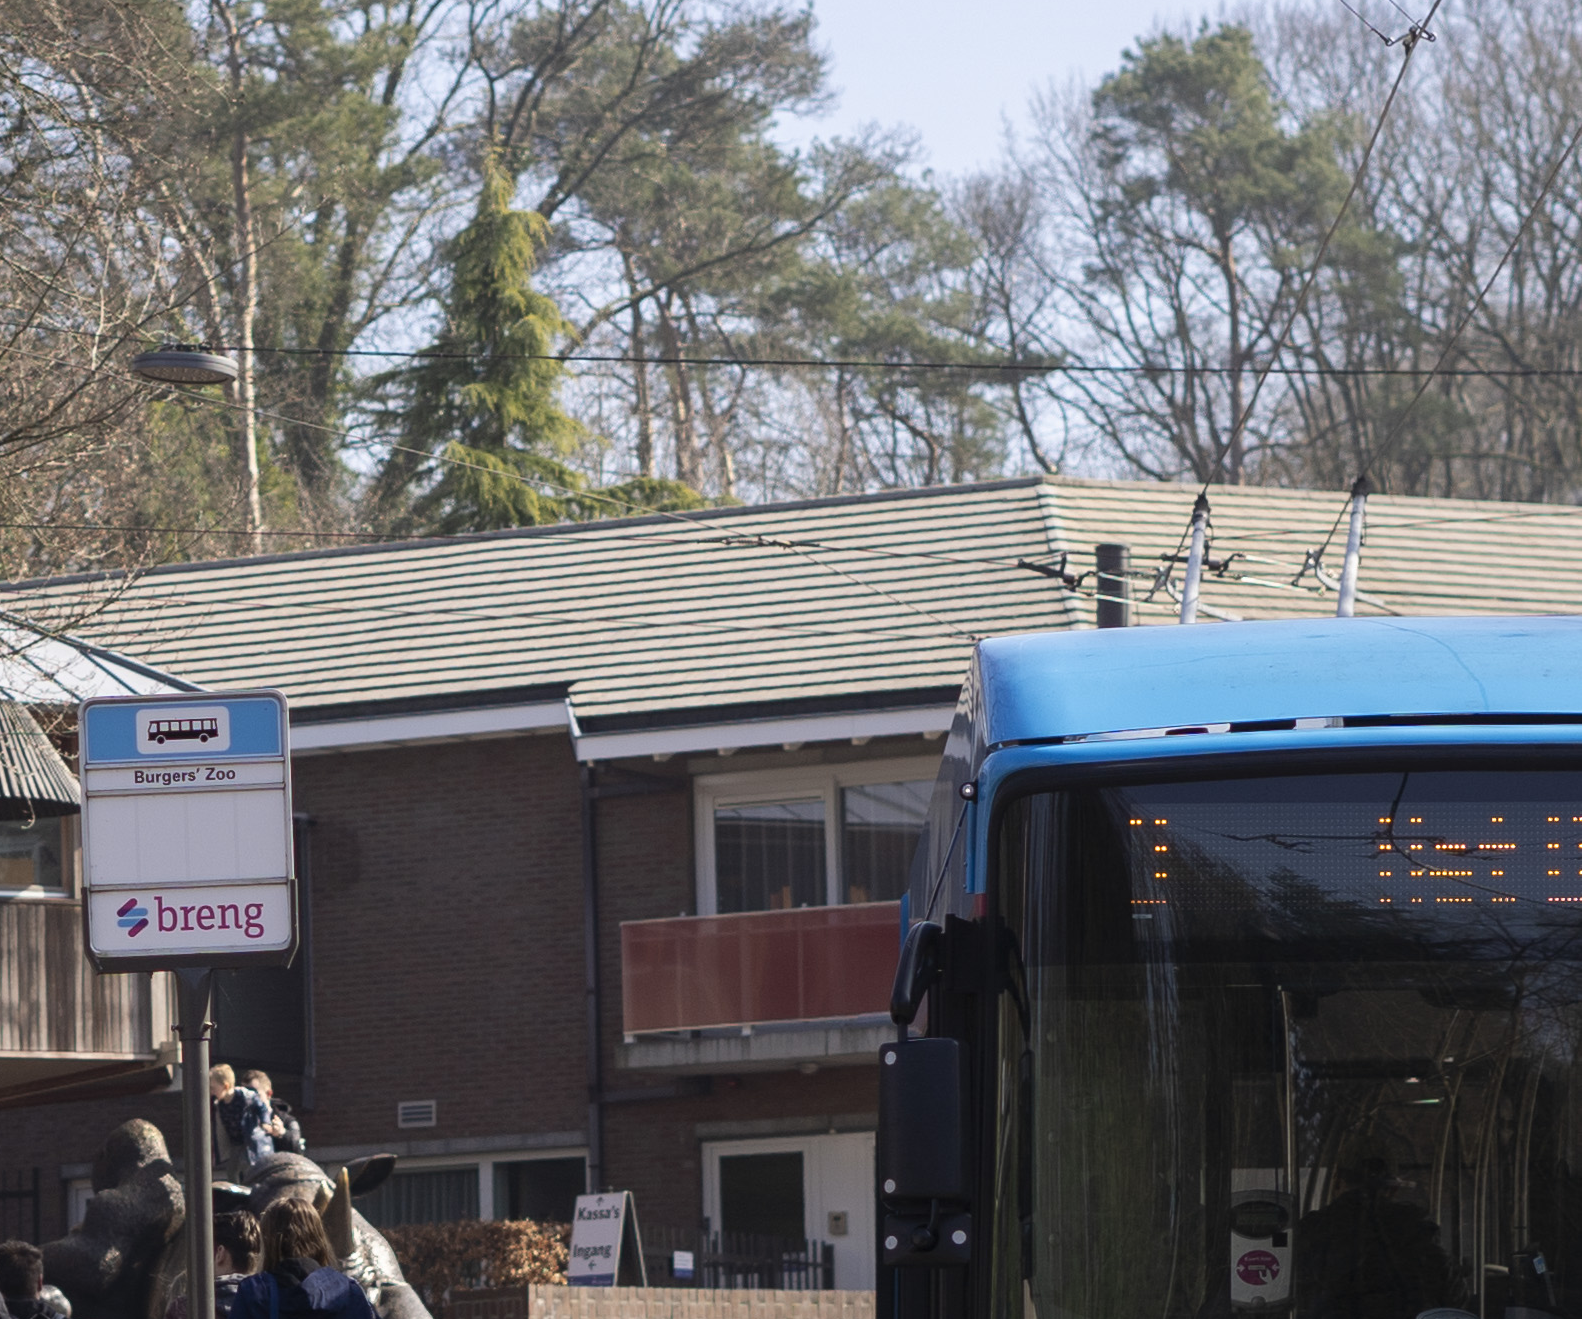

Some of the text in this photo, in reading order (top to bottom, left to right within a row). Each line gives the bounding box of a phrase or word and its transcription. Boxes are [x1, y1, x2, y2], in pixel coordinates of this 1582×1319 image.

[134, 767, 236, 786] Burgers' Zoo
[154, 896, 265, 939] breng
[578, 1205, 620, 1221] Kassa's
[573, 1243, 613, 1260] Ingang
